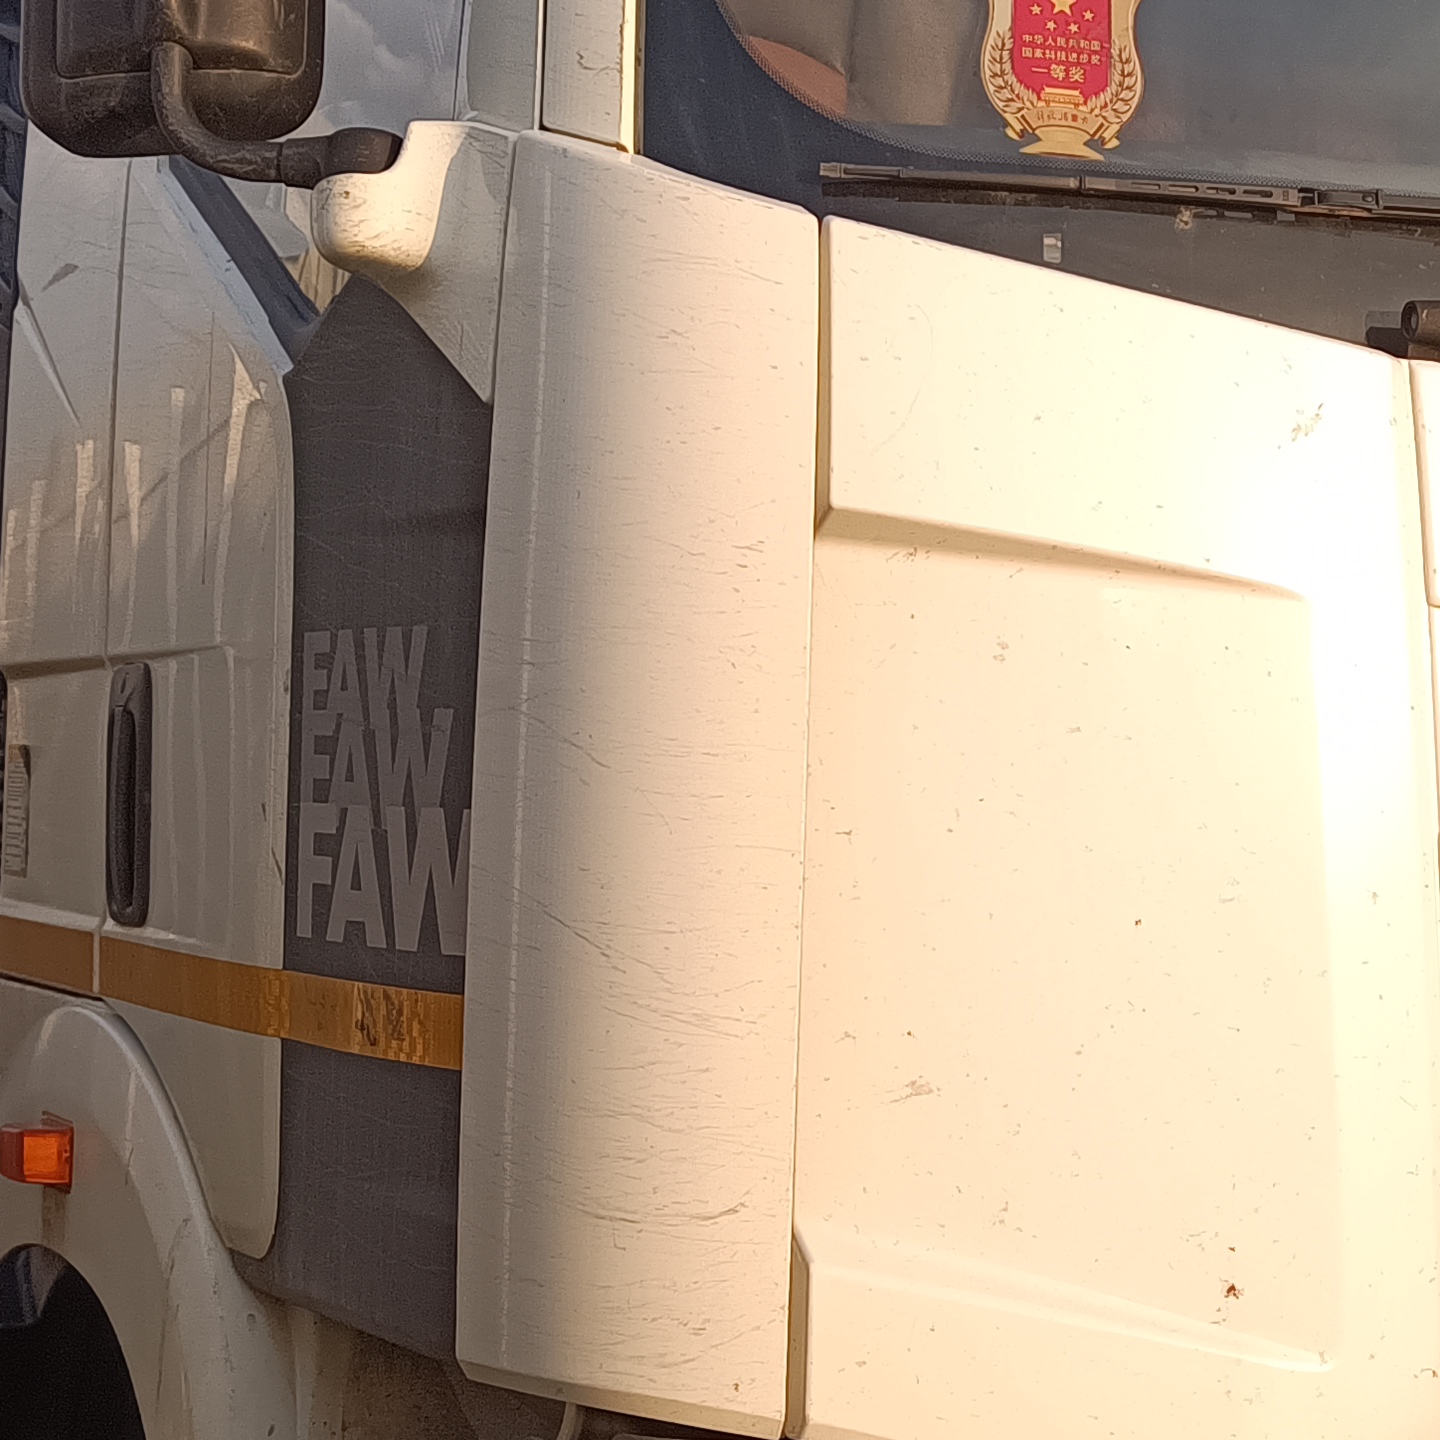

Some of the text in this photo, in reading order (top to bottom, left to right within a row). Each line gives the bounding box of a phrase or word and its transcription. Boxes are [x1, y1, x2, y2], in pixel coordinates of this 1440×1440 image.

[1022, 34, 1101, 51] 中华人民共和国
[1031, 64, 1084, 82] 一等奖
[296, 802, 471, 956] FAW
